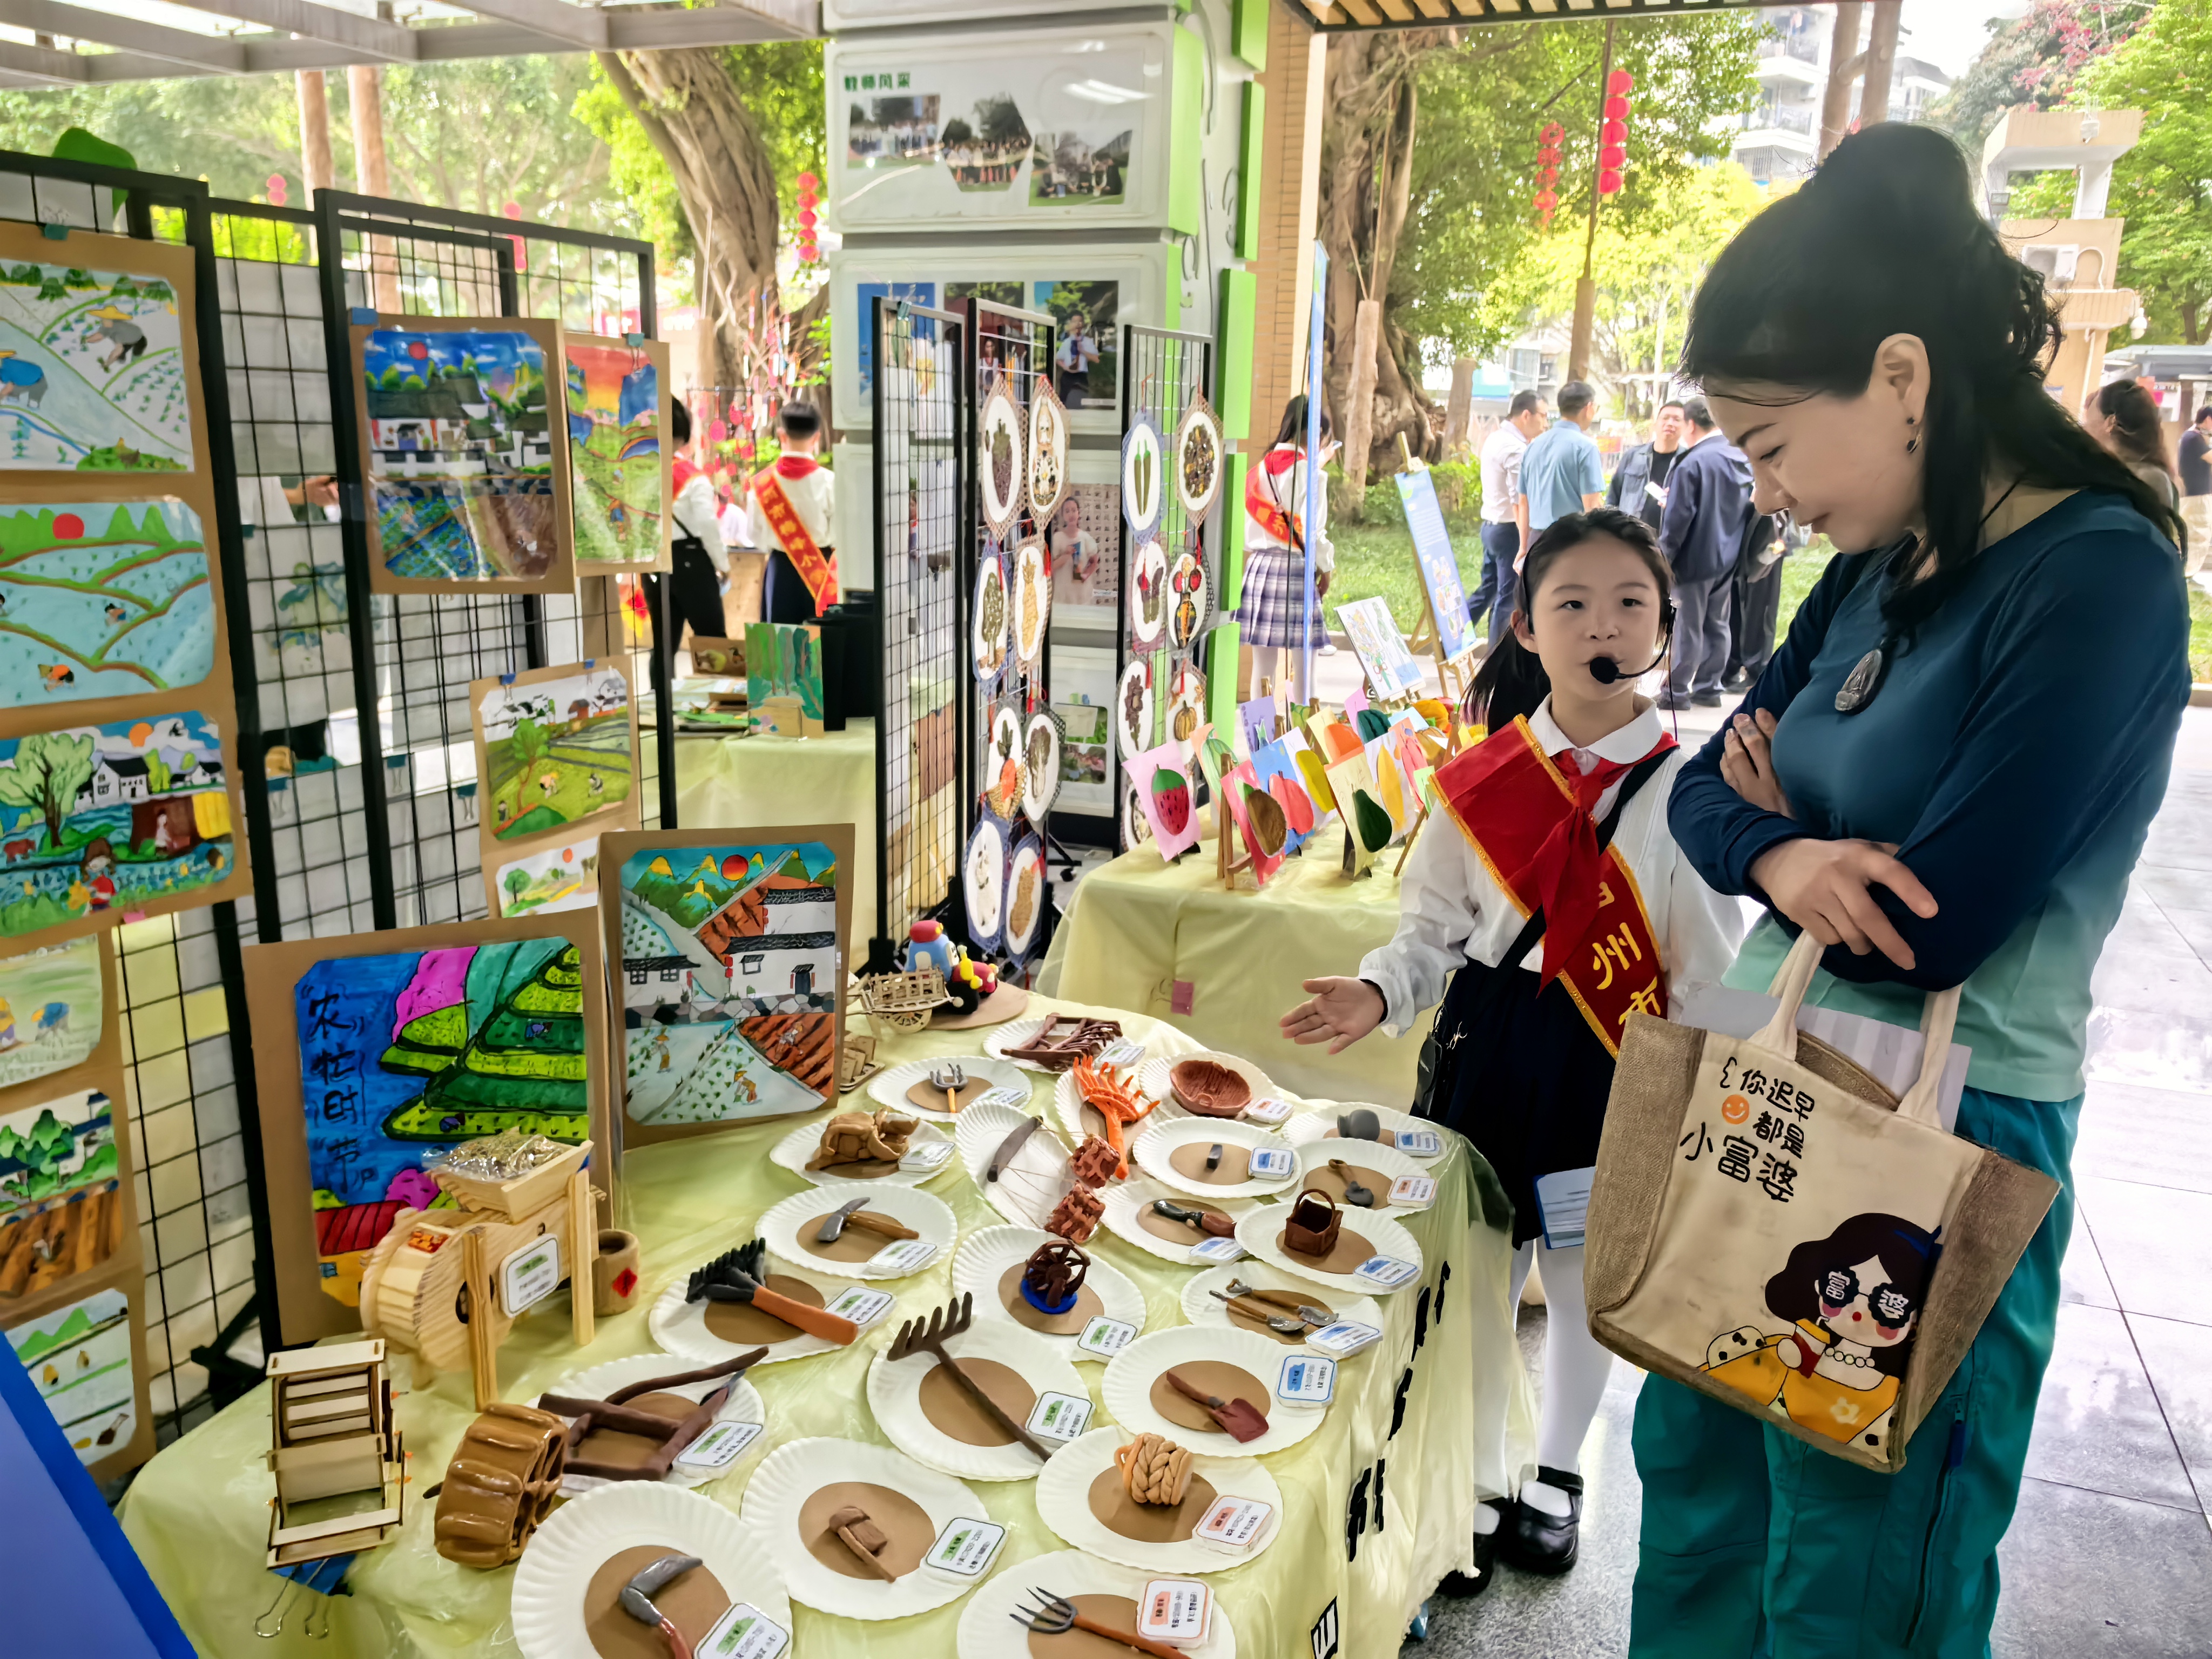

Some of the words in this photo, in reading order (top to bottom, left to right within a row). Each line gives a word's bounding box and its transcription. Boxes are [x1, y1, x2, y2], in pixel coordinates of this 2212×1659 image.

[1740, 1069, 1815, 1122] 你迟早
[1752, 1111, 1804, 1159] 都是
[1680, 1122, 1797, 1203] 小富婆
